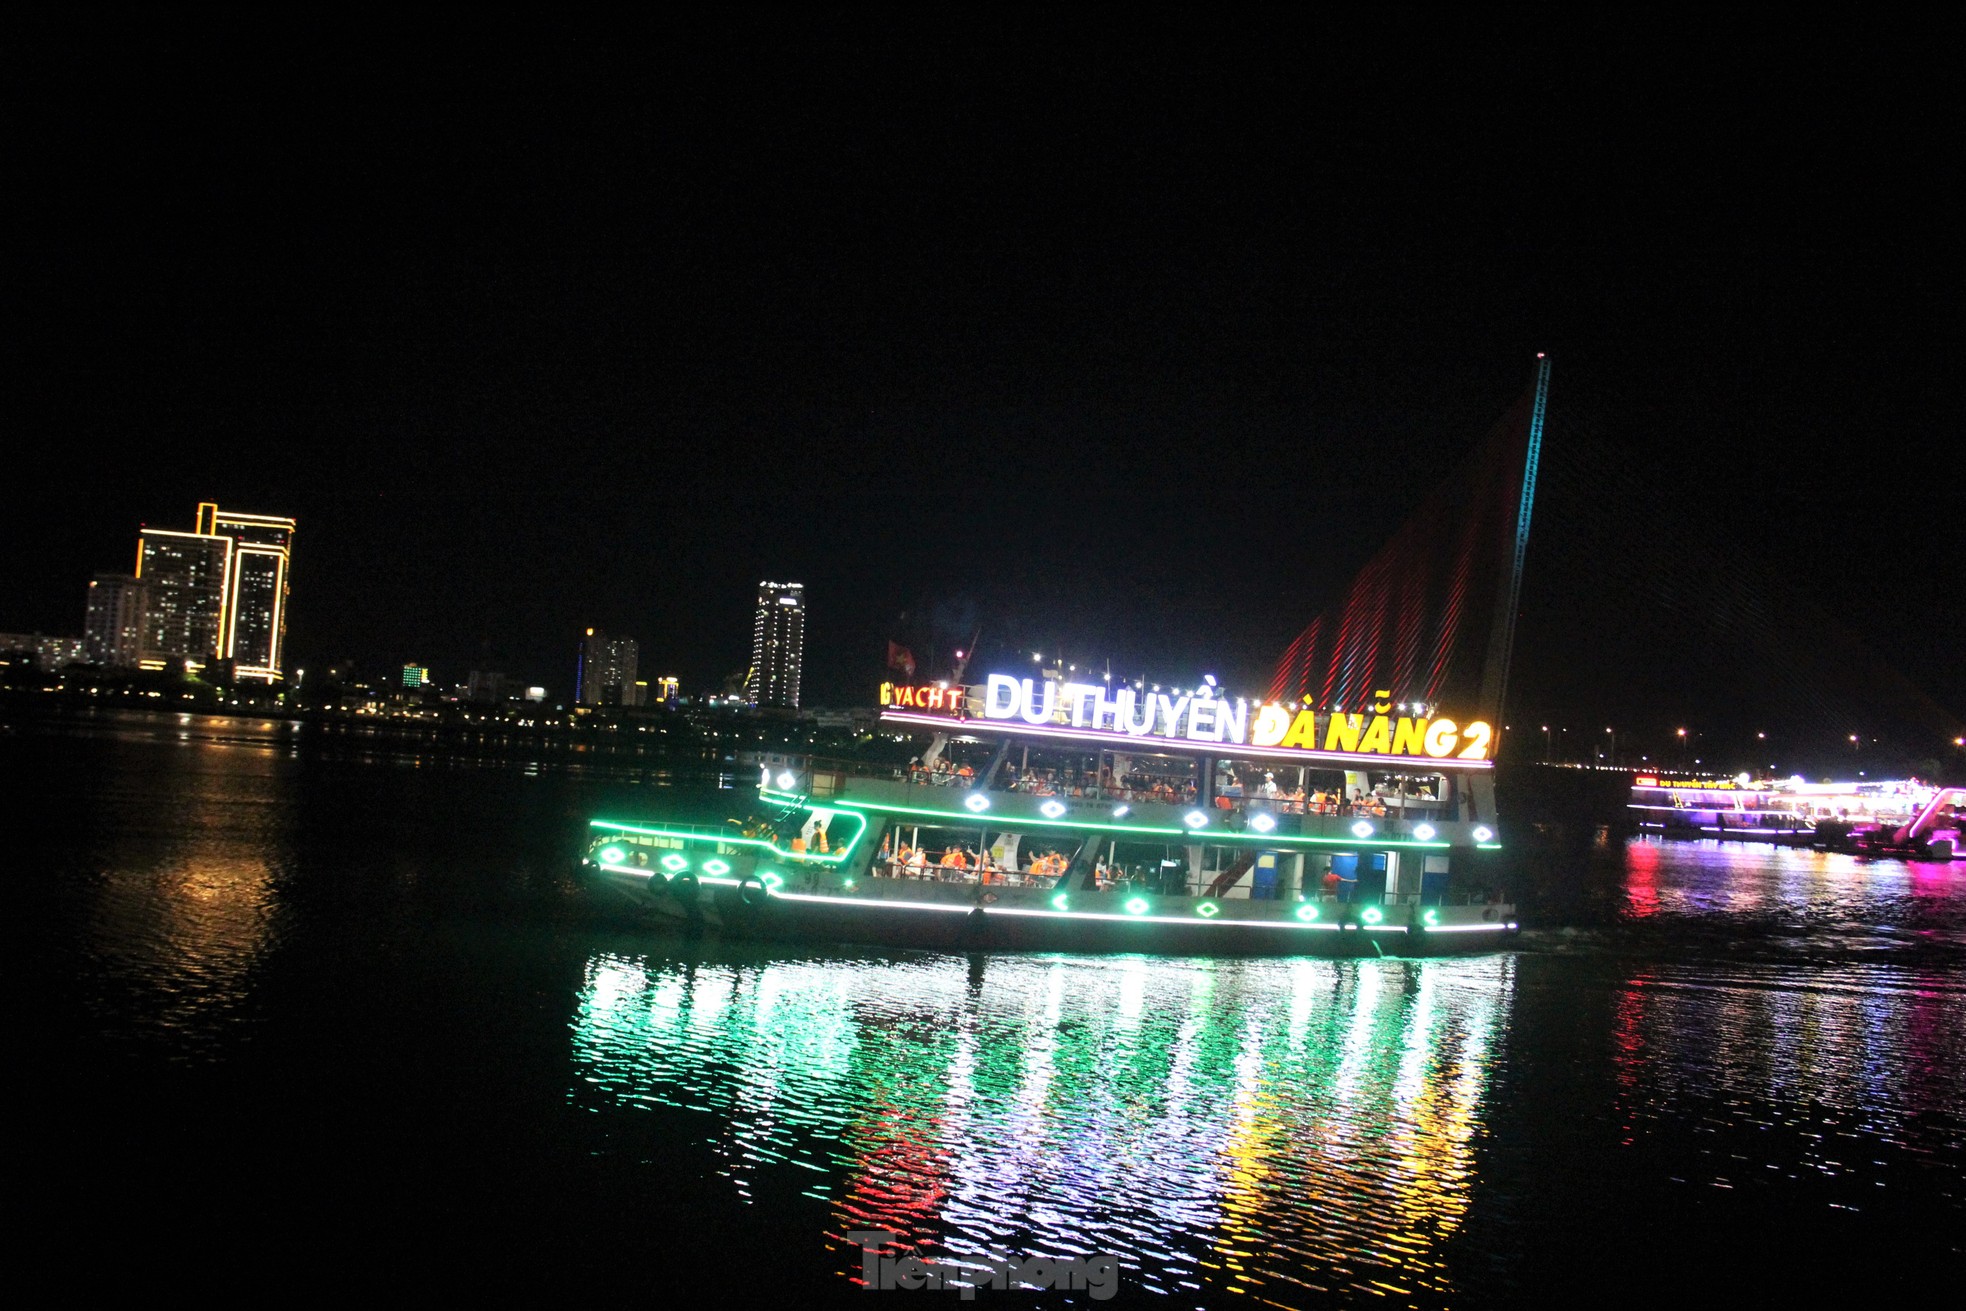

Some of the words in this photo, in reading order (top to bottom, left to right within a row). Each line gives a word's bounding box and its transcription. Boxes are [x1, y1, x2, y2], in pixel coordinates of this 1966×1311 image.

[894, 685, 963, 710] YACHT
[984, 673, 1056, 725] DU
[1062, 674, 1248, 744] THUYỀN
[1251, 693, 1316, 750] ĐÀ
[1323, 689, 1458, 758] NẴNG
[1457, 720, 1492, 760] 2
